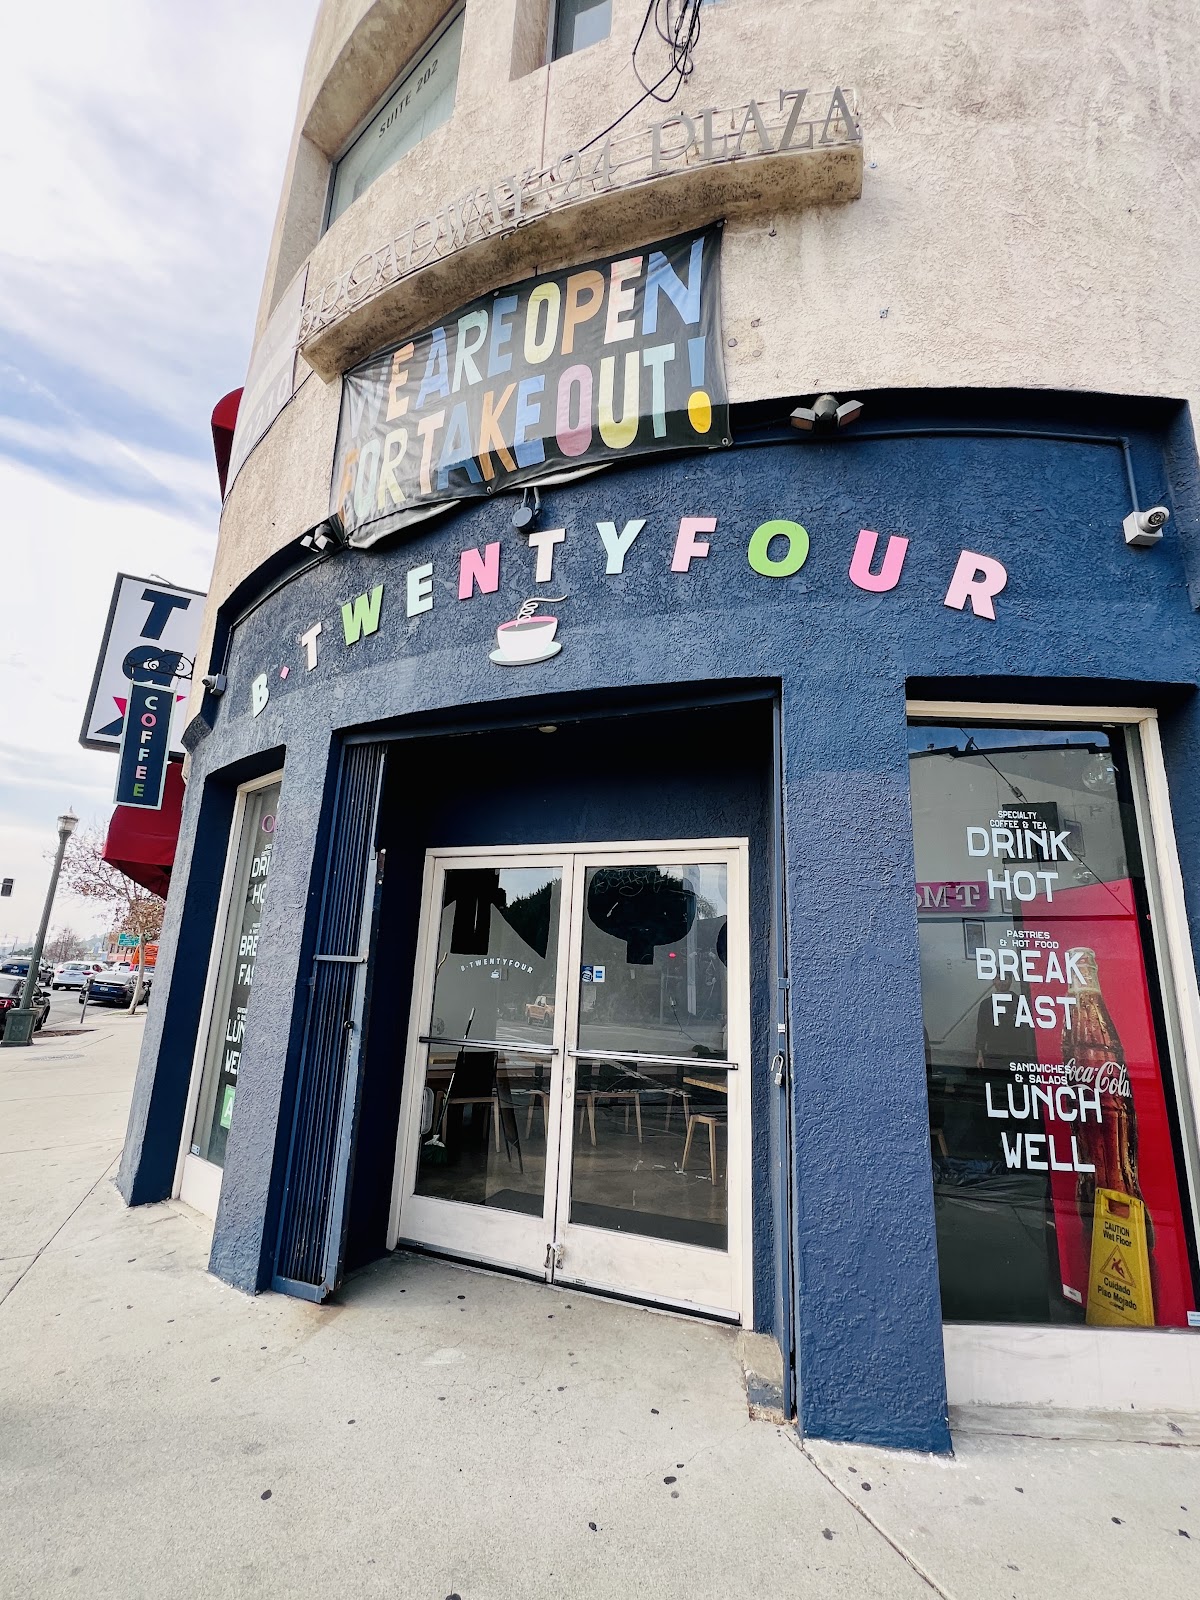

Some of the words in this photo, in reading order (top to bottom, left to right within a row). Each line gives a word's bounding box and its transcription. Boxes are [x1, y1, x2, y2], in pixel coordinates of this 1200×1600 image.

[378, 90, 412, 138] SUITE
[416, 59, 439, 94] 202
[555, 138, 619, 200] 24
[648, 86, 861, 176] PLAZA
[345, 342, 415, 440] WE
[416, 294, 518, 411] ARE
[523, 237, 706, 366] OPEN
[338, 427, 408, 524] FOR
[133, 696, 159, 798] COFFEE
[989, 819, 1019, 829] COFFEE
[1022, 821, 1030, 829] &
[1032, 821, 1047, 830] TEA
[997, 810, 1037, 820] SPECIALTY
[966, 826, 1074, 861] DRINK
[987, 868, 1059, 903] HOT
[1000, 939, 1008, 947] &
[1012, 940, 1030, 948] HOT
[1035, 940, 1059, 949] FOOD
[1006, 930, 1050, 940] PASTRIES
[975, 947, 1087, 986] BREAK
[991, 993, 1077, 1030] FAST
[1009, 1062, 1071, 1074] SANDWICHES
[1015, 1073, 1023, 1083] &
[1029, 1074, 1068, 1086] SALADS
[985, 1080, 1103, 1123] LUNCH
[1000, 1131, 1096, 1173] WELL
[1102, 1230, 1114, 1242] Wet
[1115, 1234, 1132, 1248] Floor
[1104, 1221, 1130, 1238] CAUTION
[1097, 1285, 1112, 1299] Piso
[1113, 1293, 1138, 1311] Mojado
[1103, 1277, 1131, 1296] Cuidado
